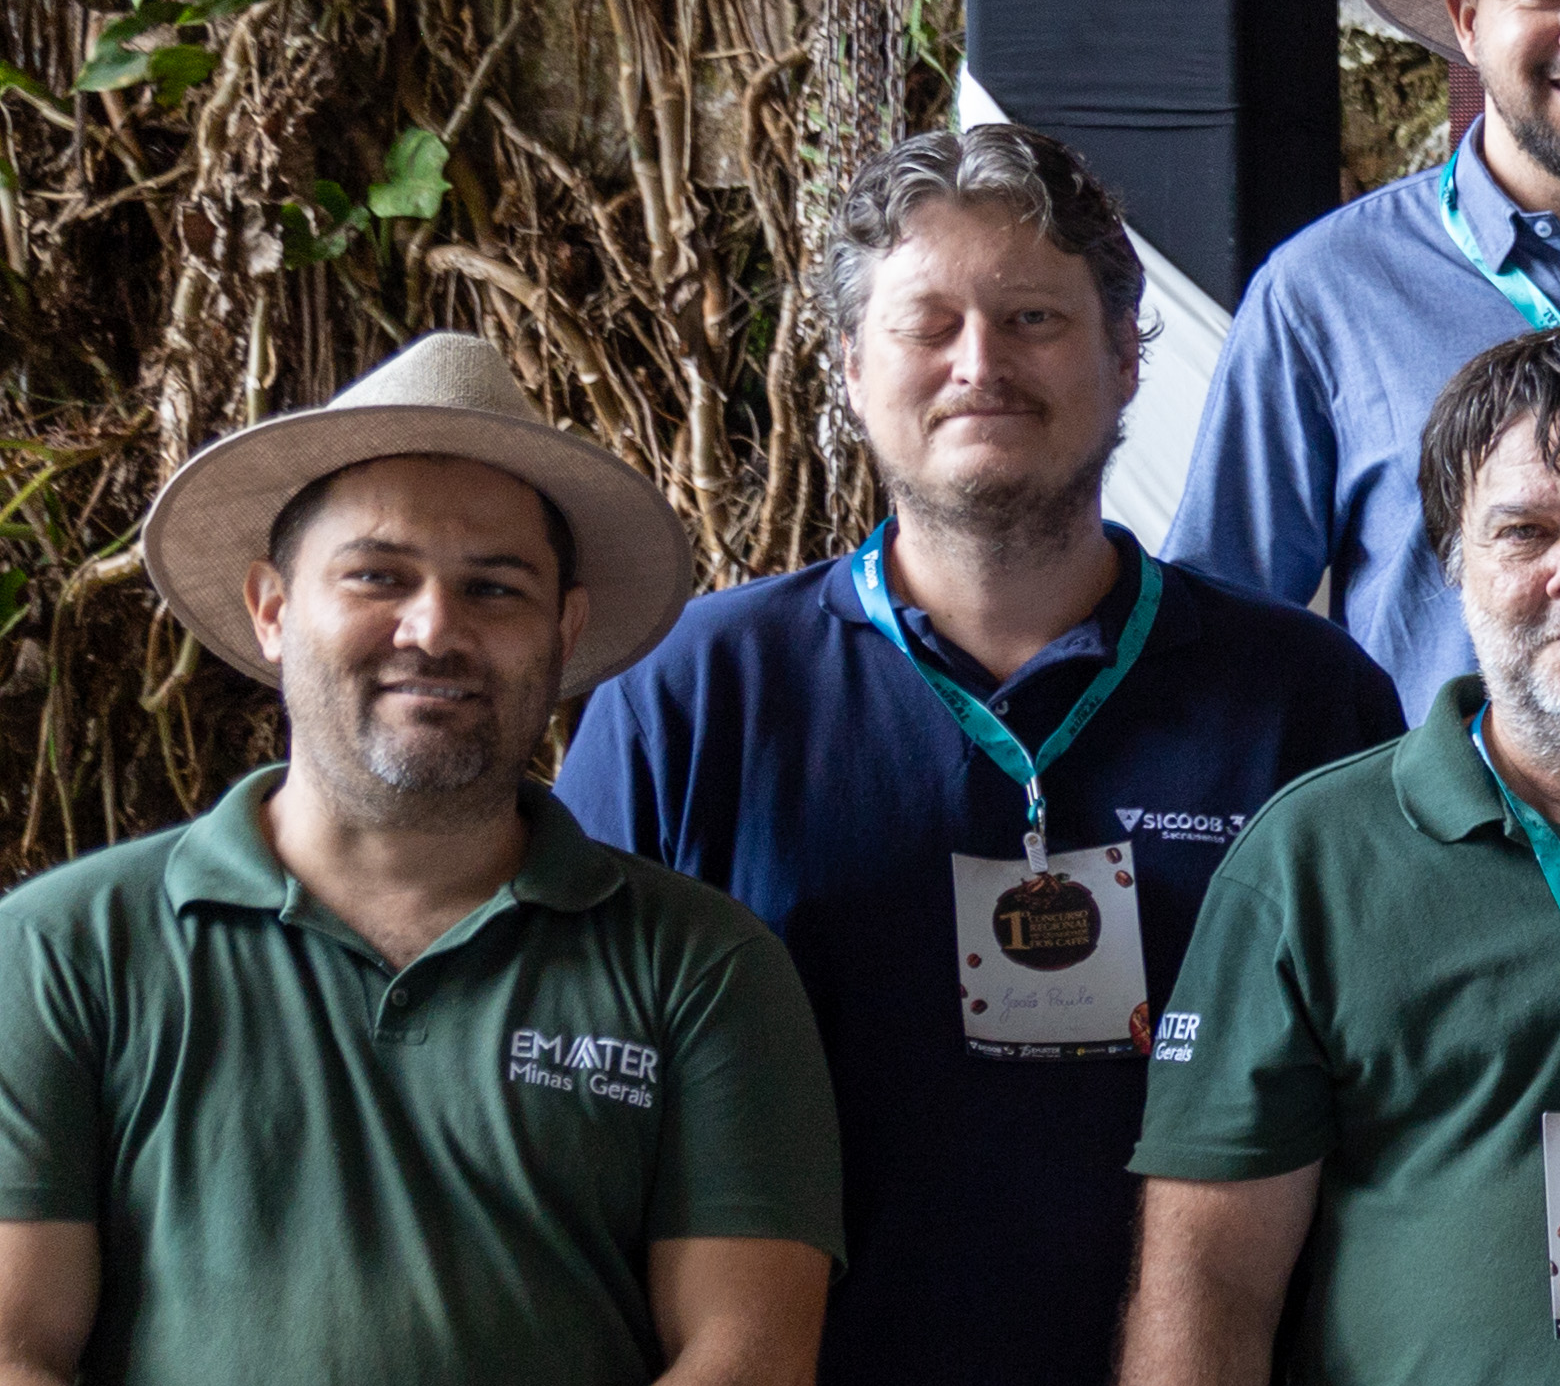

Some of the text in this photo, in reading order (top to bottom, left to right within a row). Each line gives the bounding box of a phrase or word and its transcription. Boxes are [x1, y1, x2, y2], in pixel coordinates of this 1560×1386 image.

[1142, 813, 1223, 832] SICOOB
[510, 1028, 659, 1084] EMATER
[1155, 1042, 1194, 1062] Gerais
[509, 1061, 653, 1109] Minas Gerais
